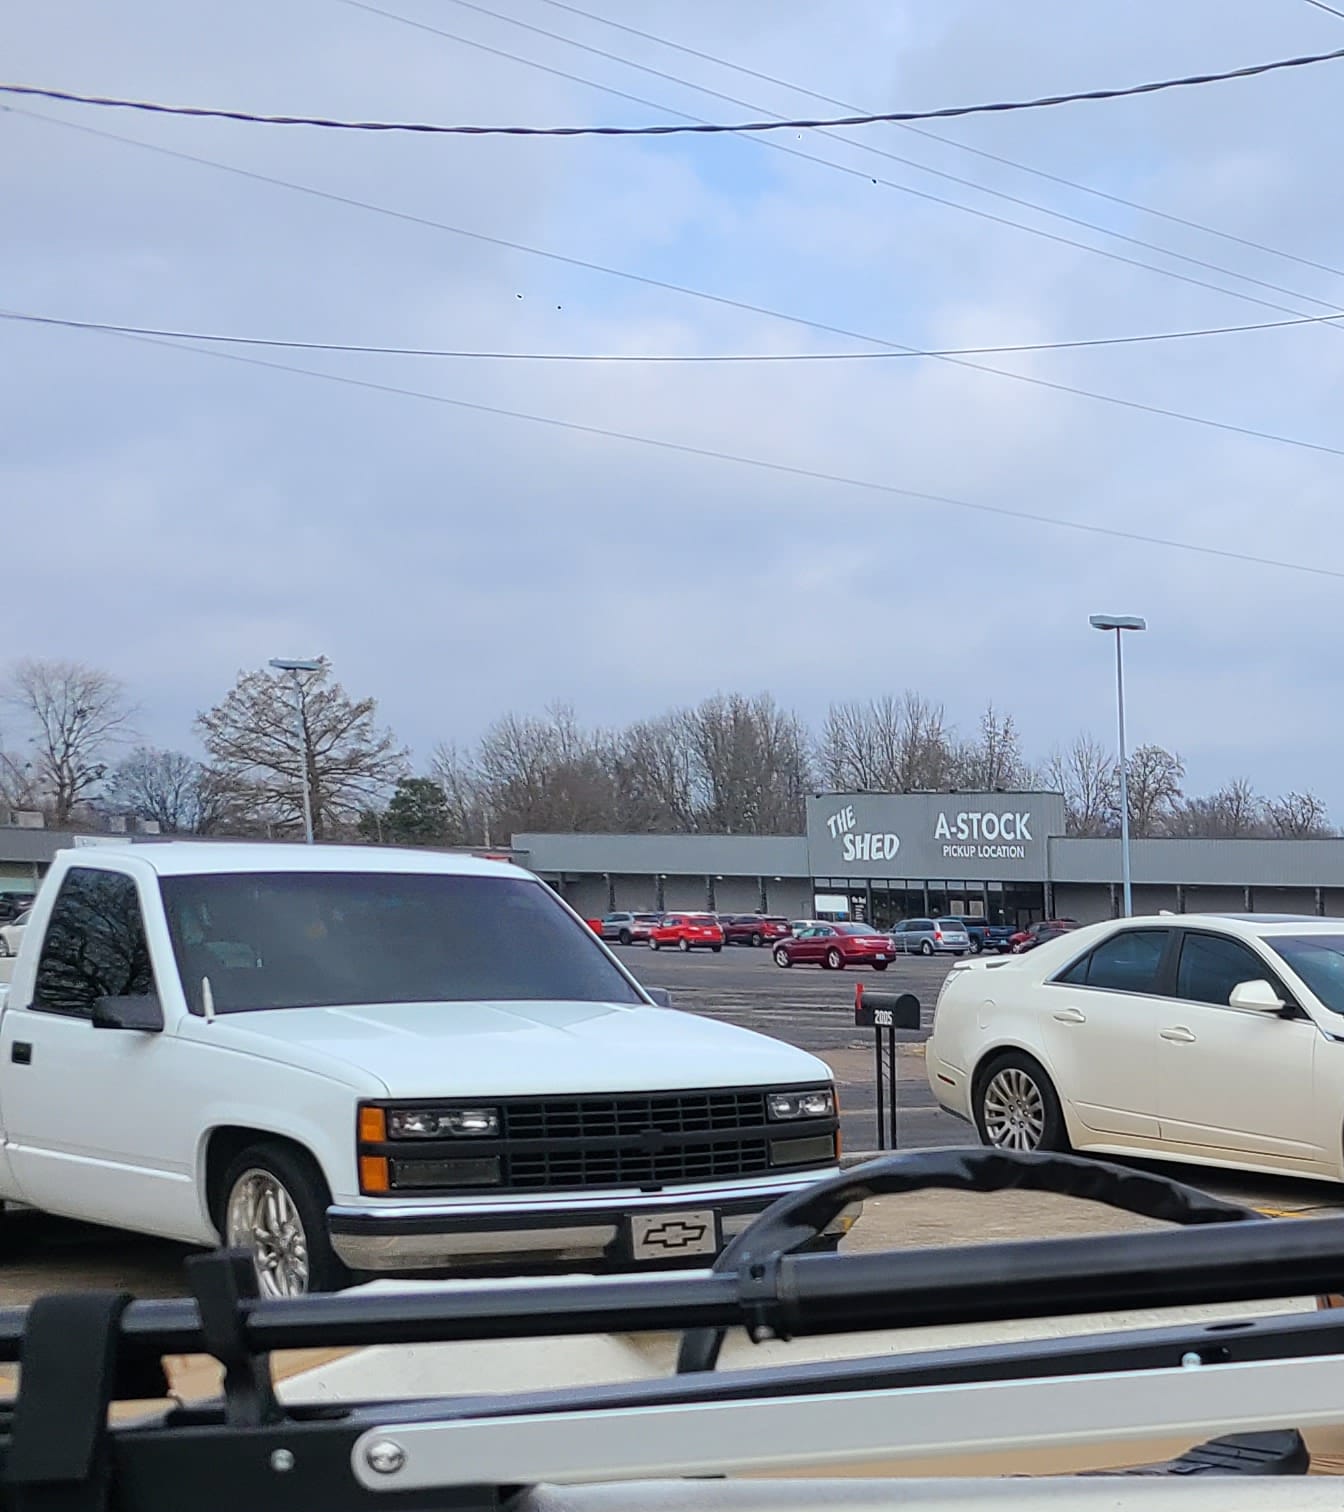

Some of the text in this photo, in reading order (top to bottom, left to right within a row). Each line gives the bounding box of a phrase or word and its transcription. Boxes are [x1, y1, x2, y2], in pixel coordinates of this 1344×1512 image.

[827, 805, 857, 839] THE
[934, 812, 1033, 841] A-STOCK
[843, 833, 900, 862] SHED
[943, 845, 1025, 858] PICKUP LOCATION
[874, 1009, 893, 1025] 2005
